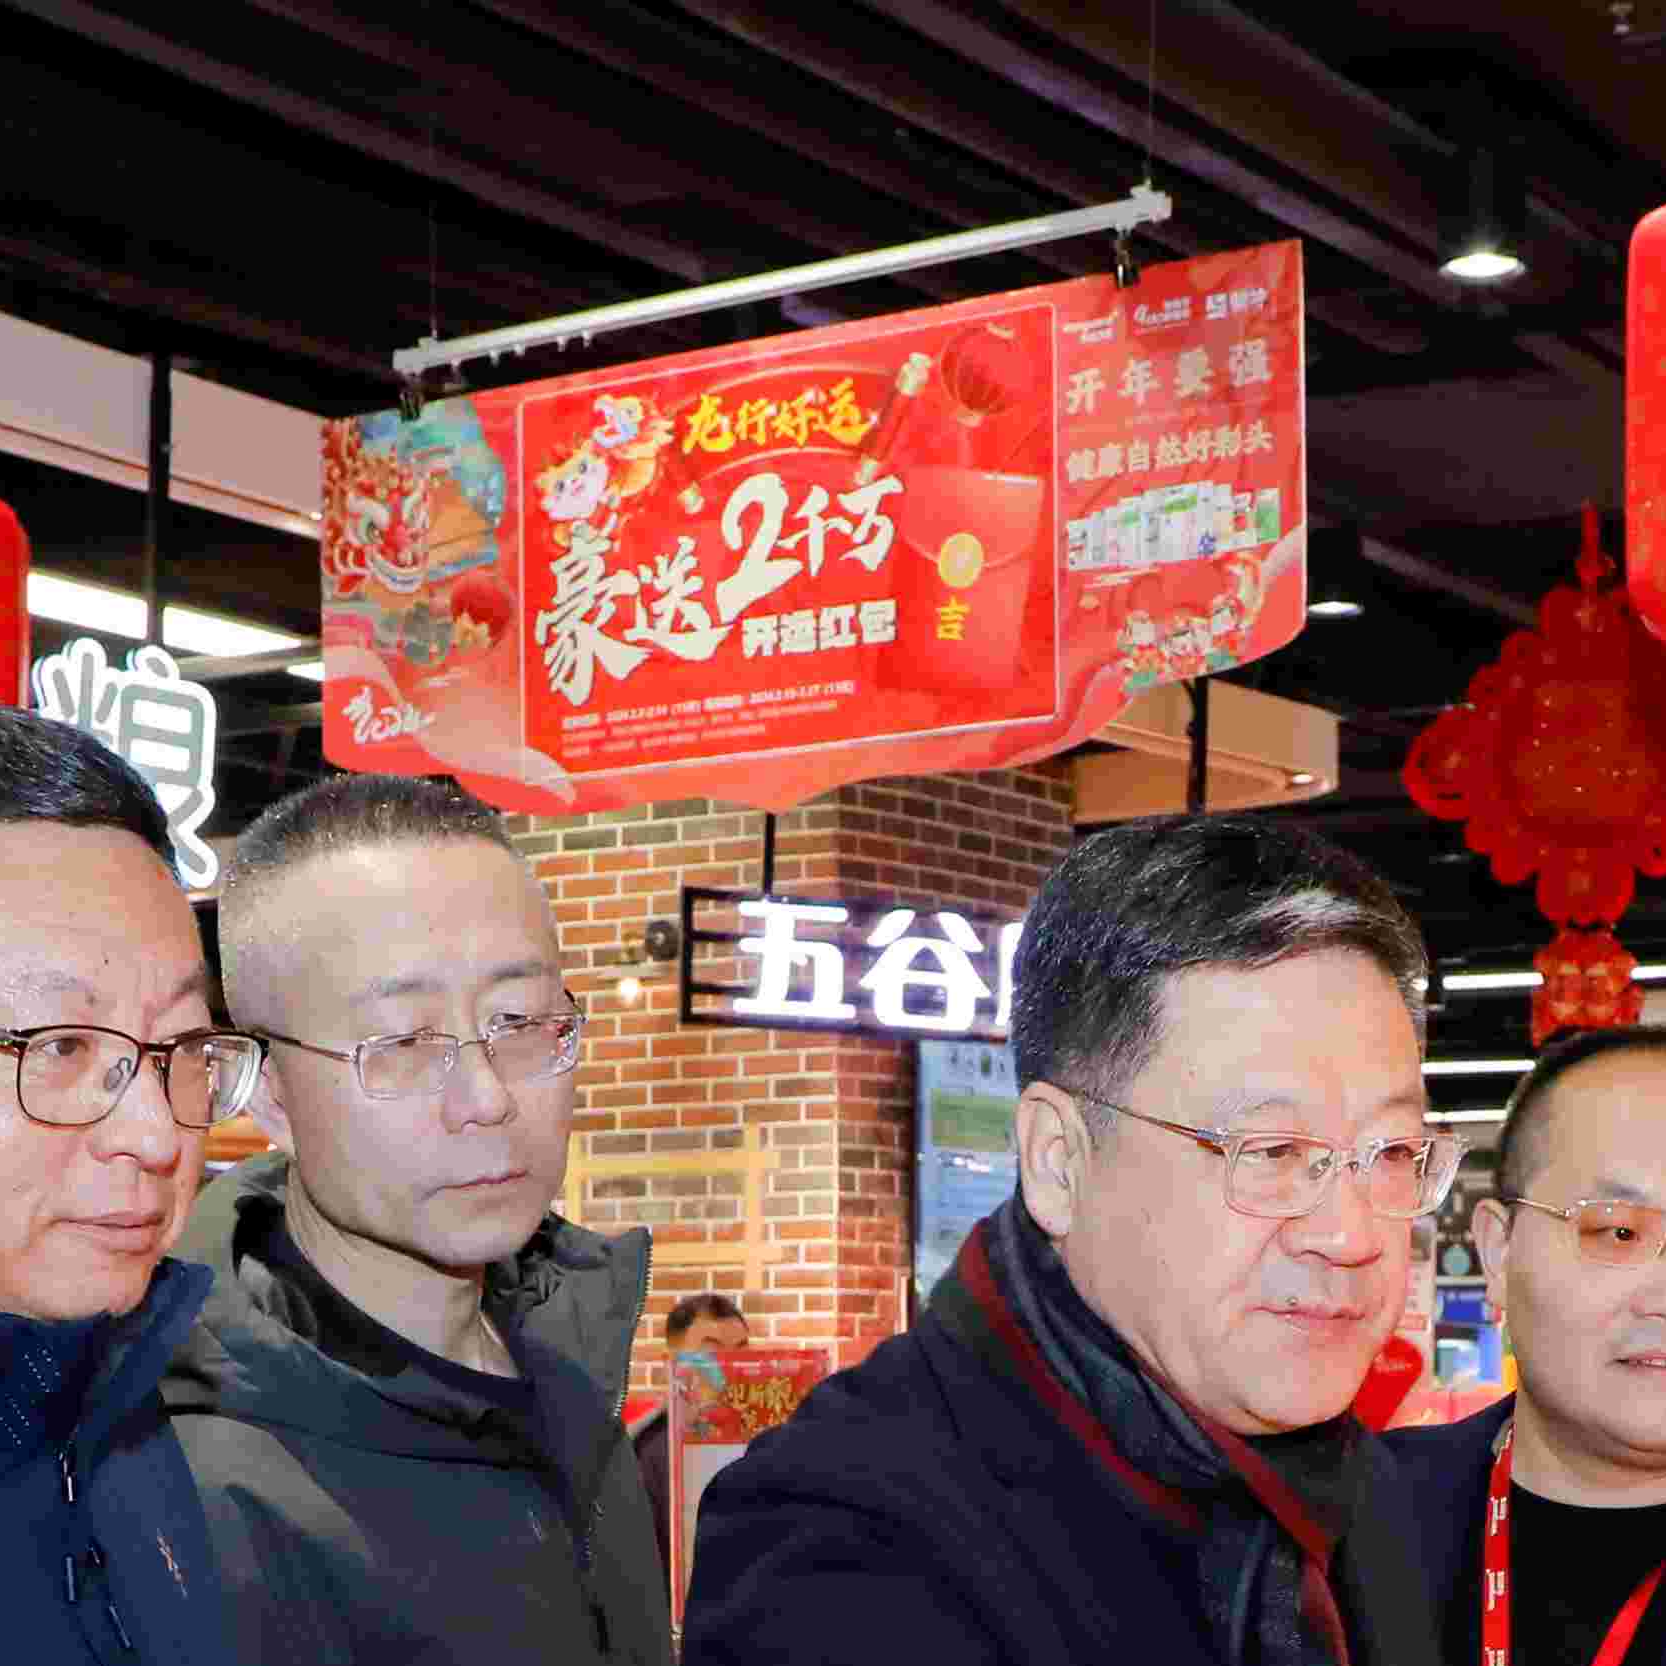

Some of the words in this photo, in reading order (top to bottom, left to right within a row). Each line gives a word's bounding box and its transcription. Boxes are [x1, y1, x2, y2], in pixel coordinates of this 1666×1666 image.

[682, 377, 879, 454] 龙行好运
[742, 599, 897, 658] 开运红包
[936, 594, 970, 640] 吉
